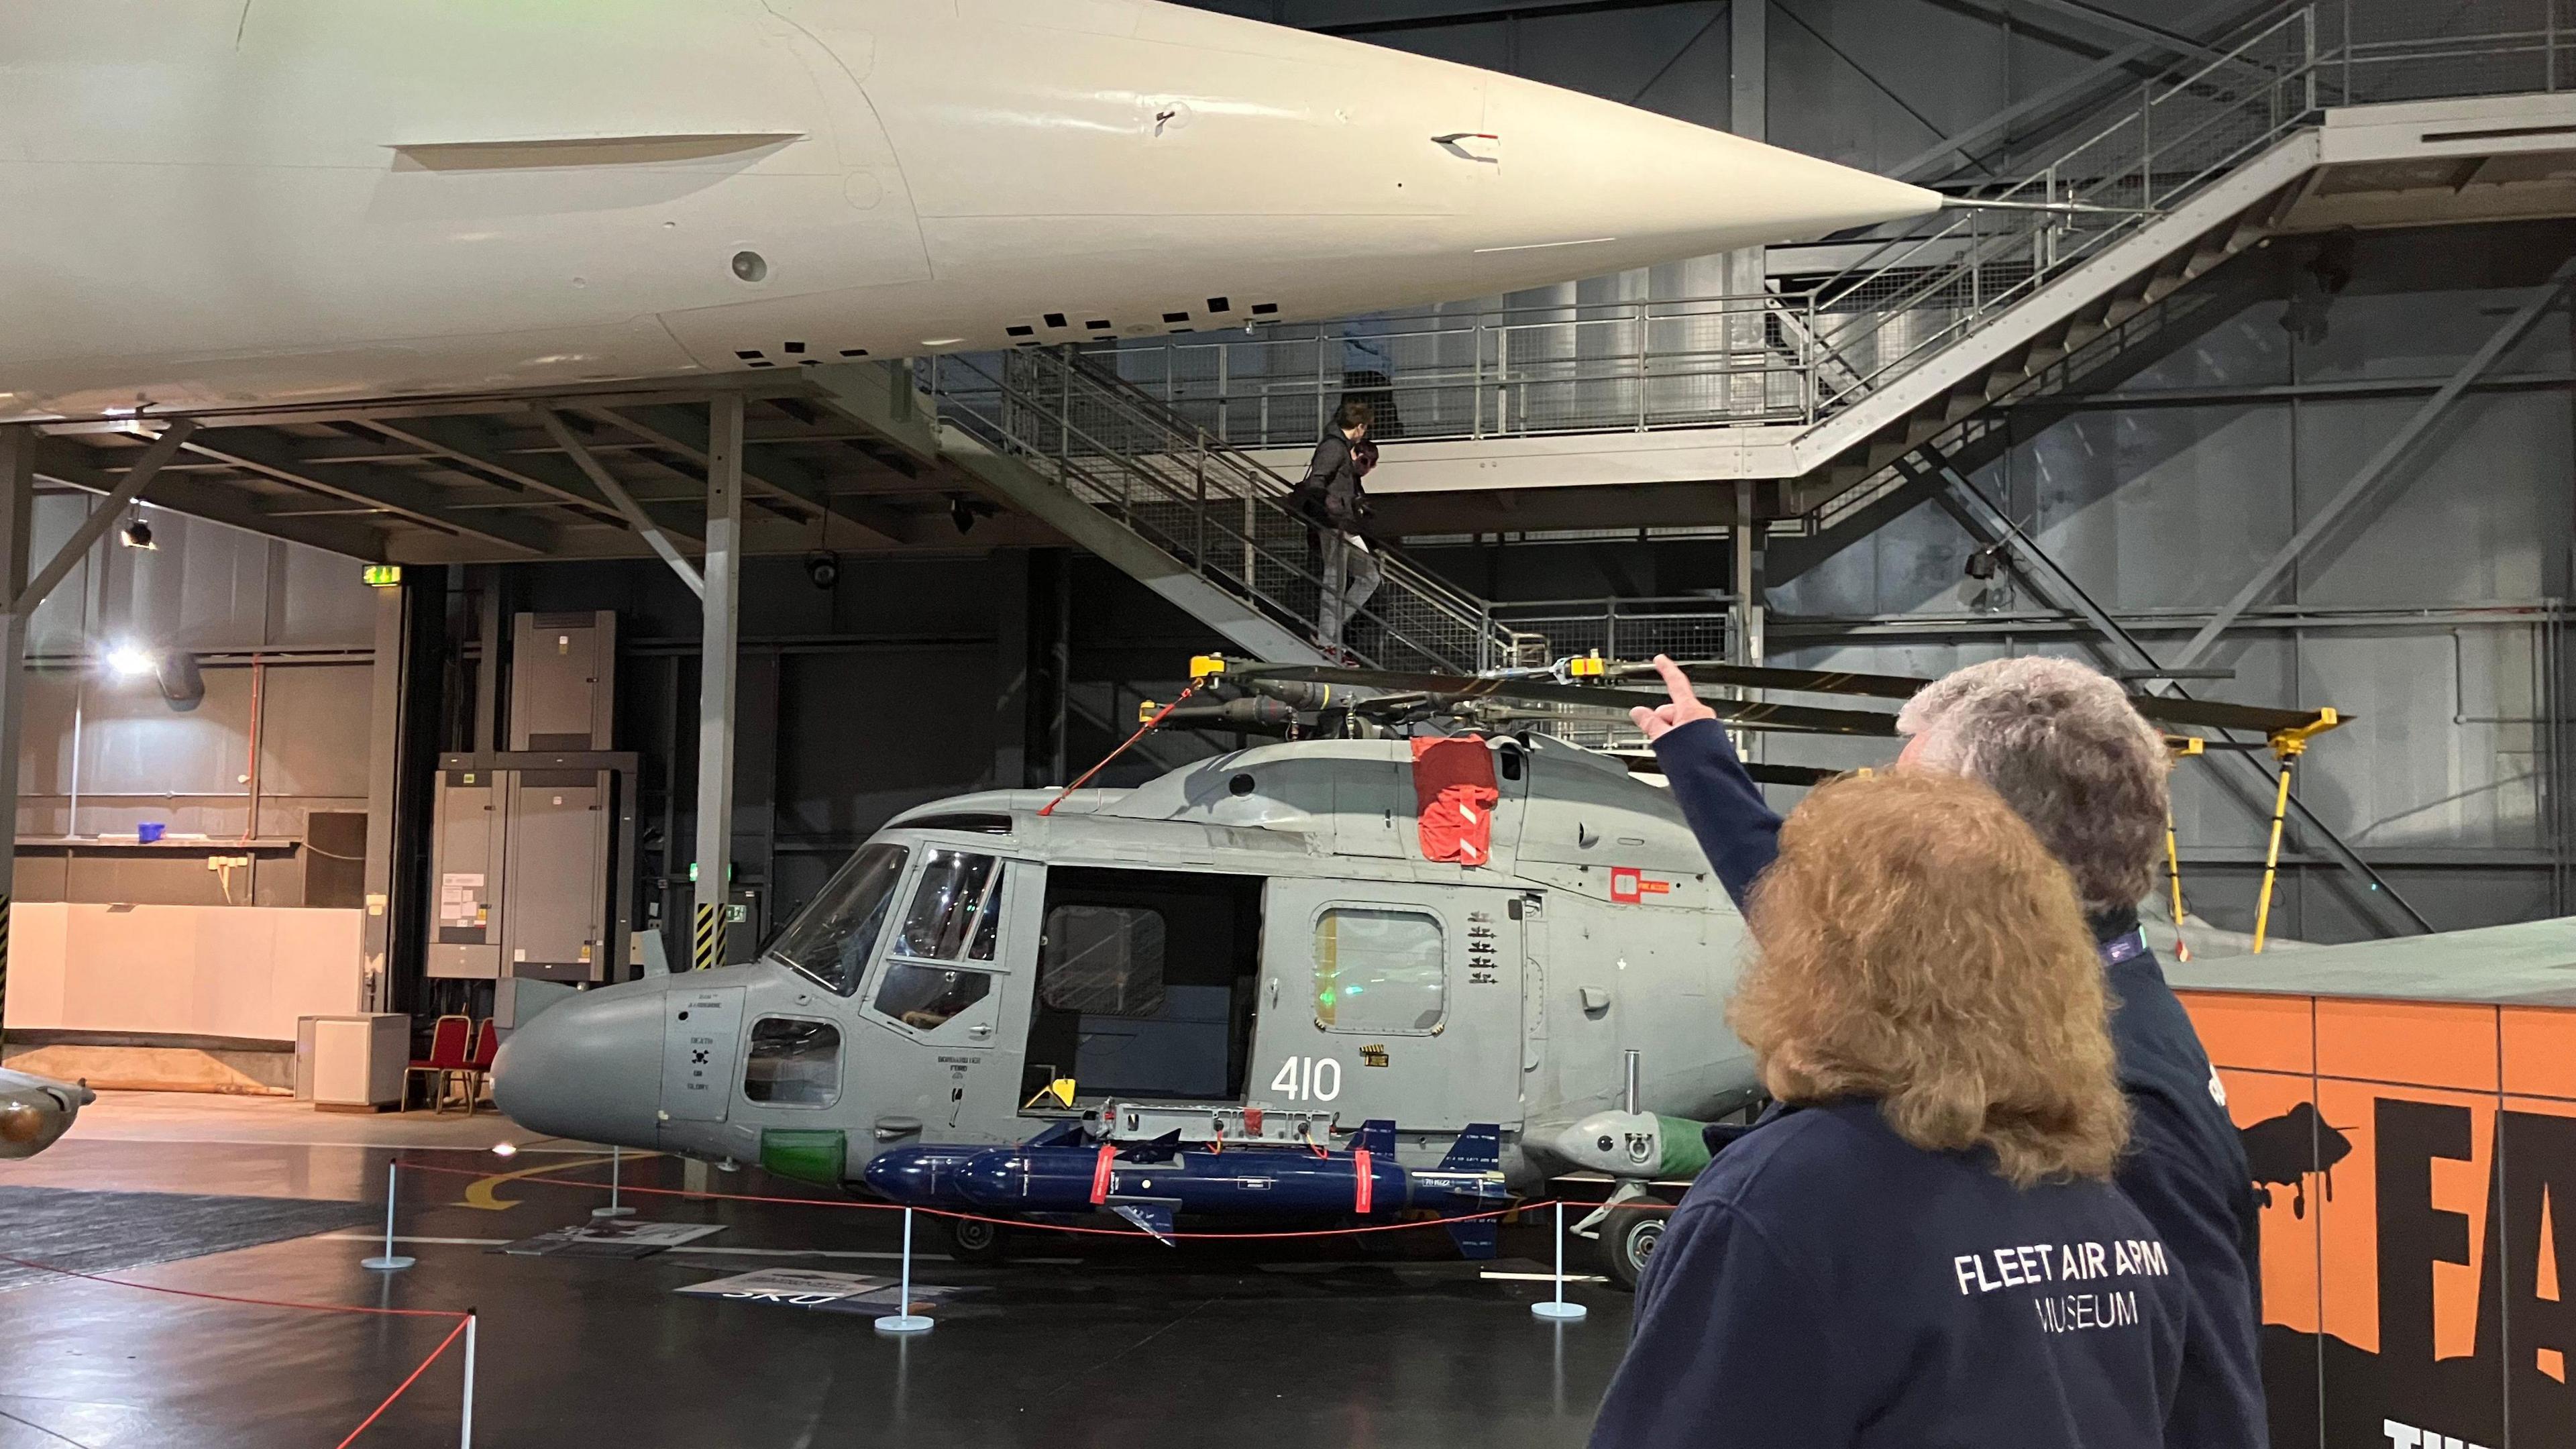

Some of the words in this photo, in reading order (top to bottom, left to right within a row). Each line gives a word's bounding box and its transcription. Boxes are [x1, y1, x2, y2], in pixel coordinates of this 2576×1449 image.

[1271, 1056, 1341, 1102] 410
[1954, 1244, 2053, 1295] FLEET
[2062, 1242, 2108, 1281] AIR
[2035, 1291, 2139, 1333] MUSEUM
